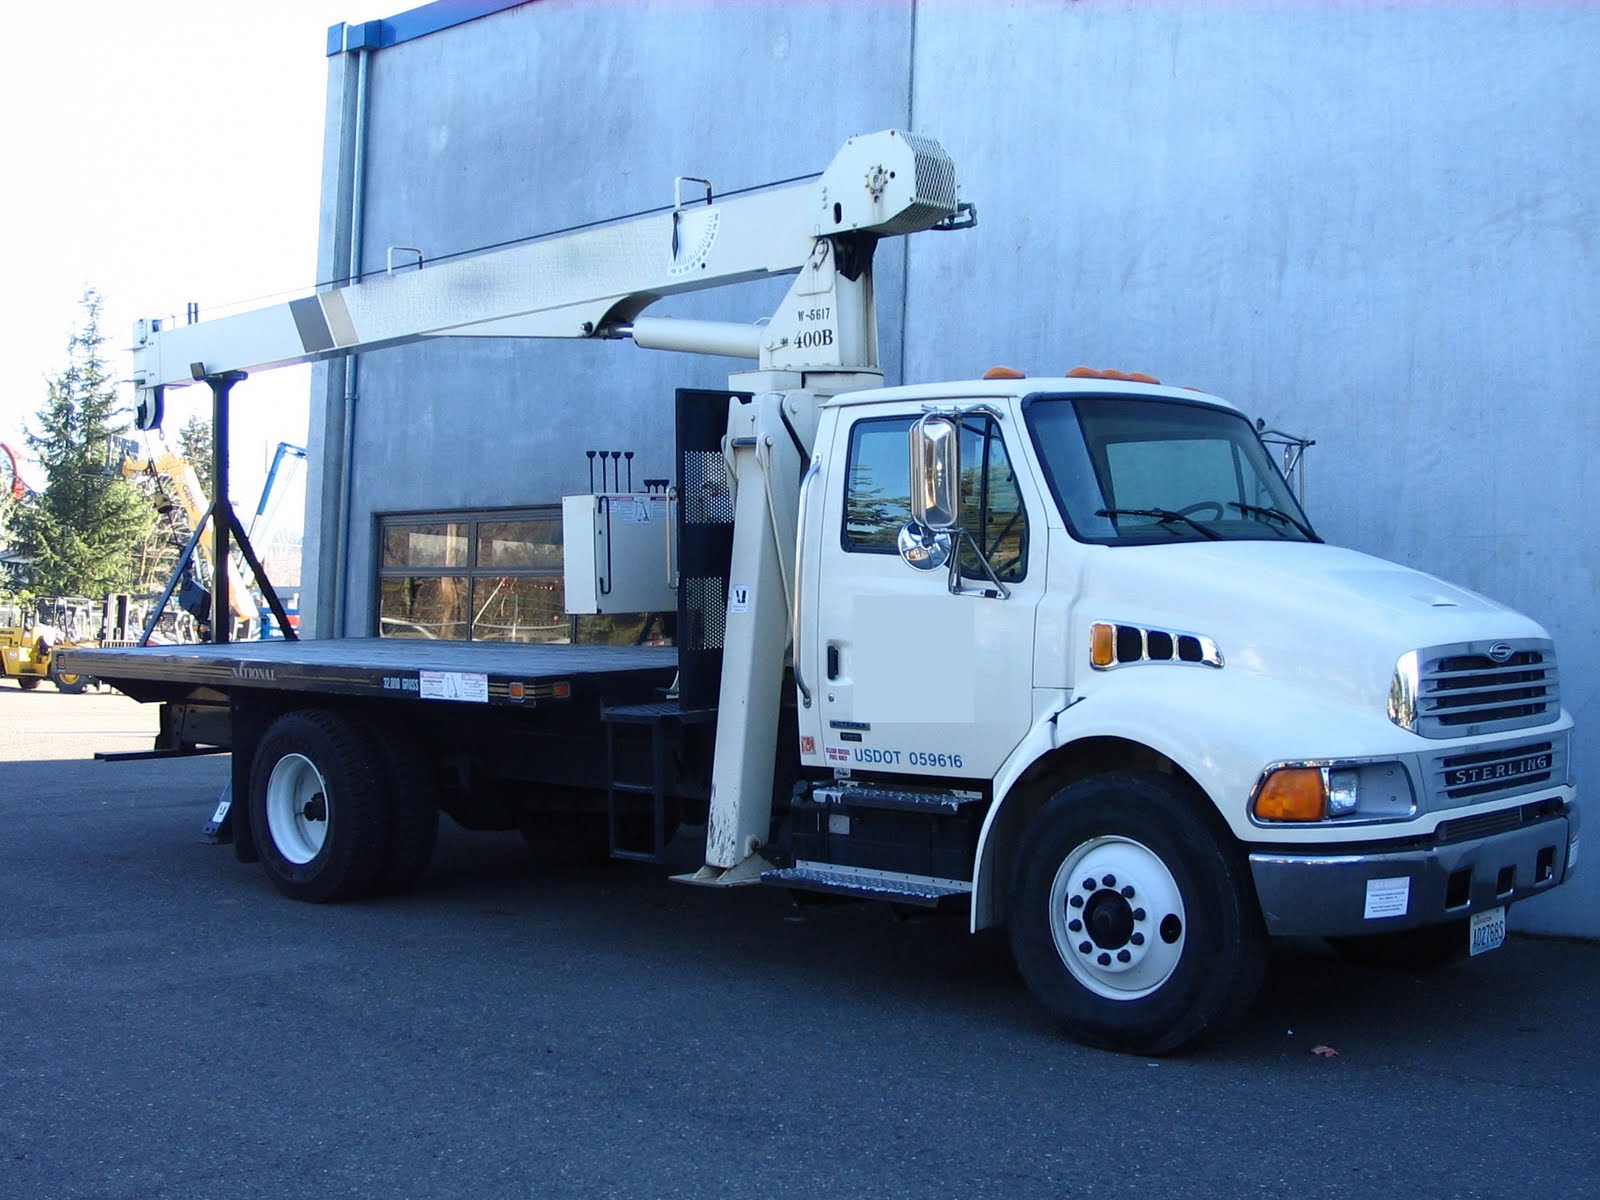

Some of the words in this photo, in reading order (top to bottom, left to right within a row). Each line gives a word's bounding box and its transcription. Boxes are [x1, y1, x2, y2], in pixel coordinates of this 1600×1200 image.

[793, 328, 833, 349] 400B
[182, 484, 197, 512] GEHL
[231, 661, 277, 681] NATIONAL
[854, 748, 901, 765] USDOT
[909, 751, 963, 769] 059616
[1455, 755, 1548, 784] STERLING
